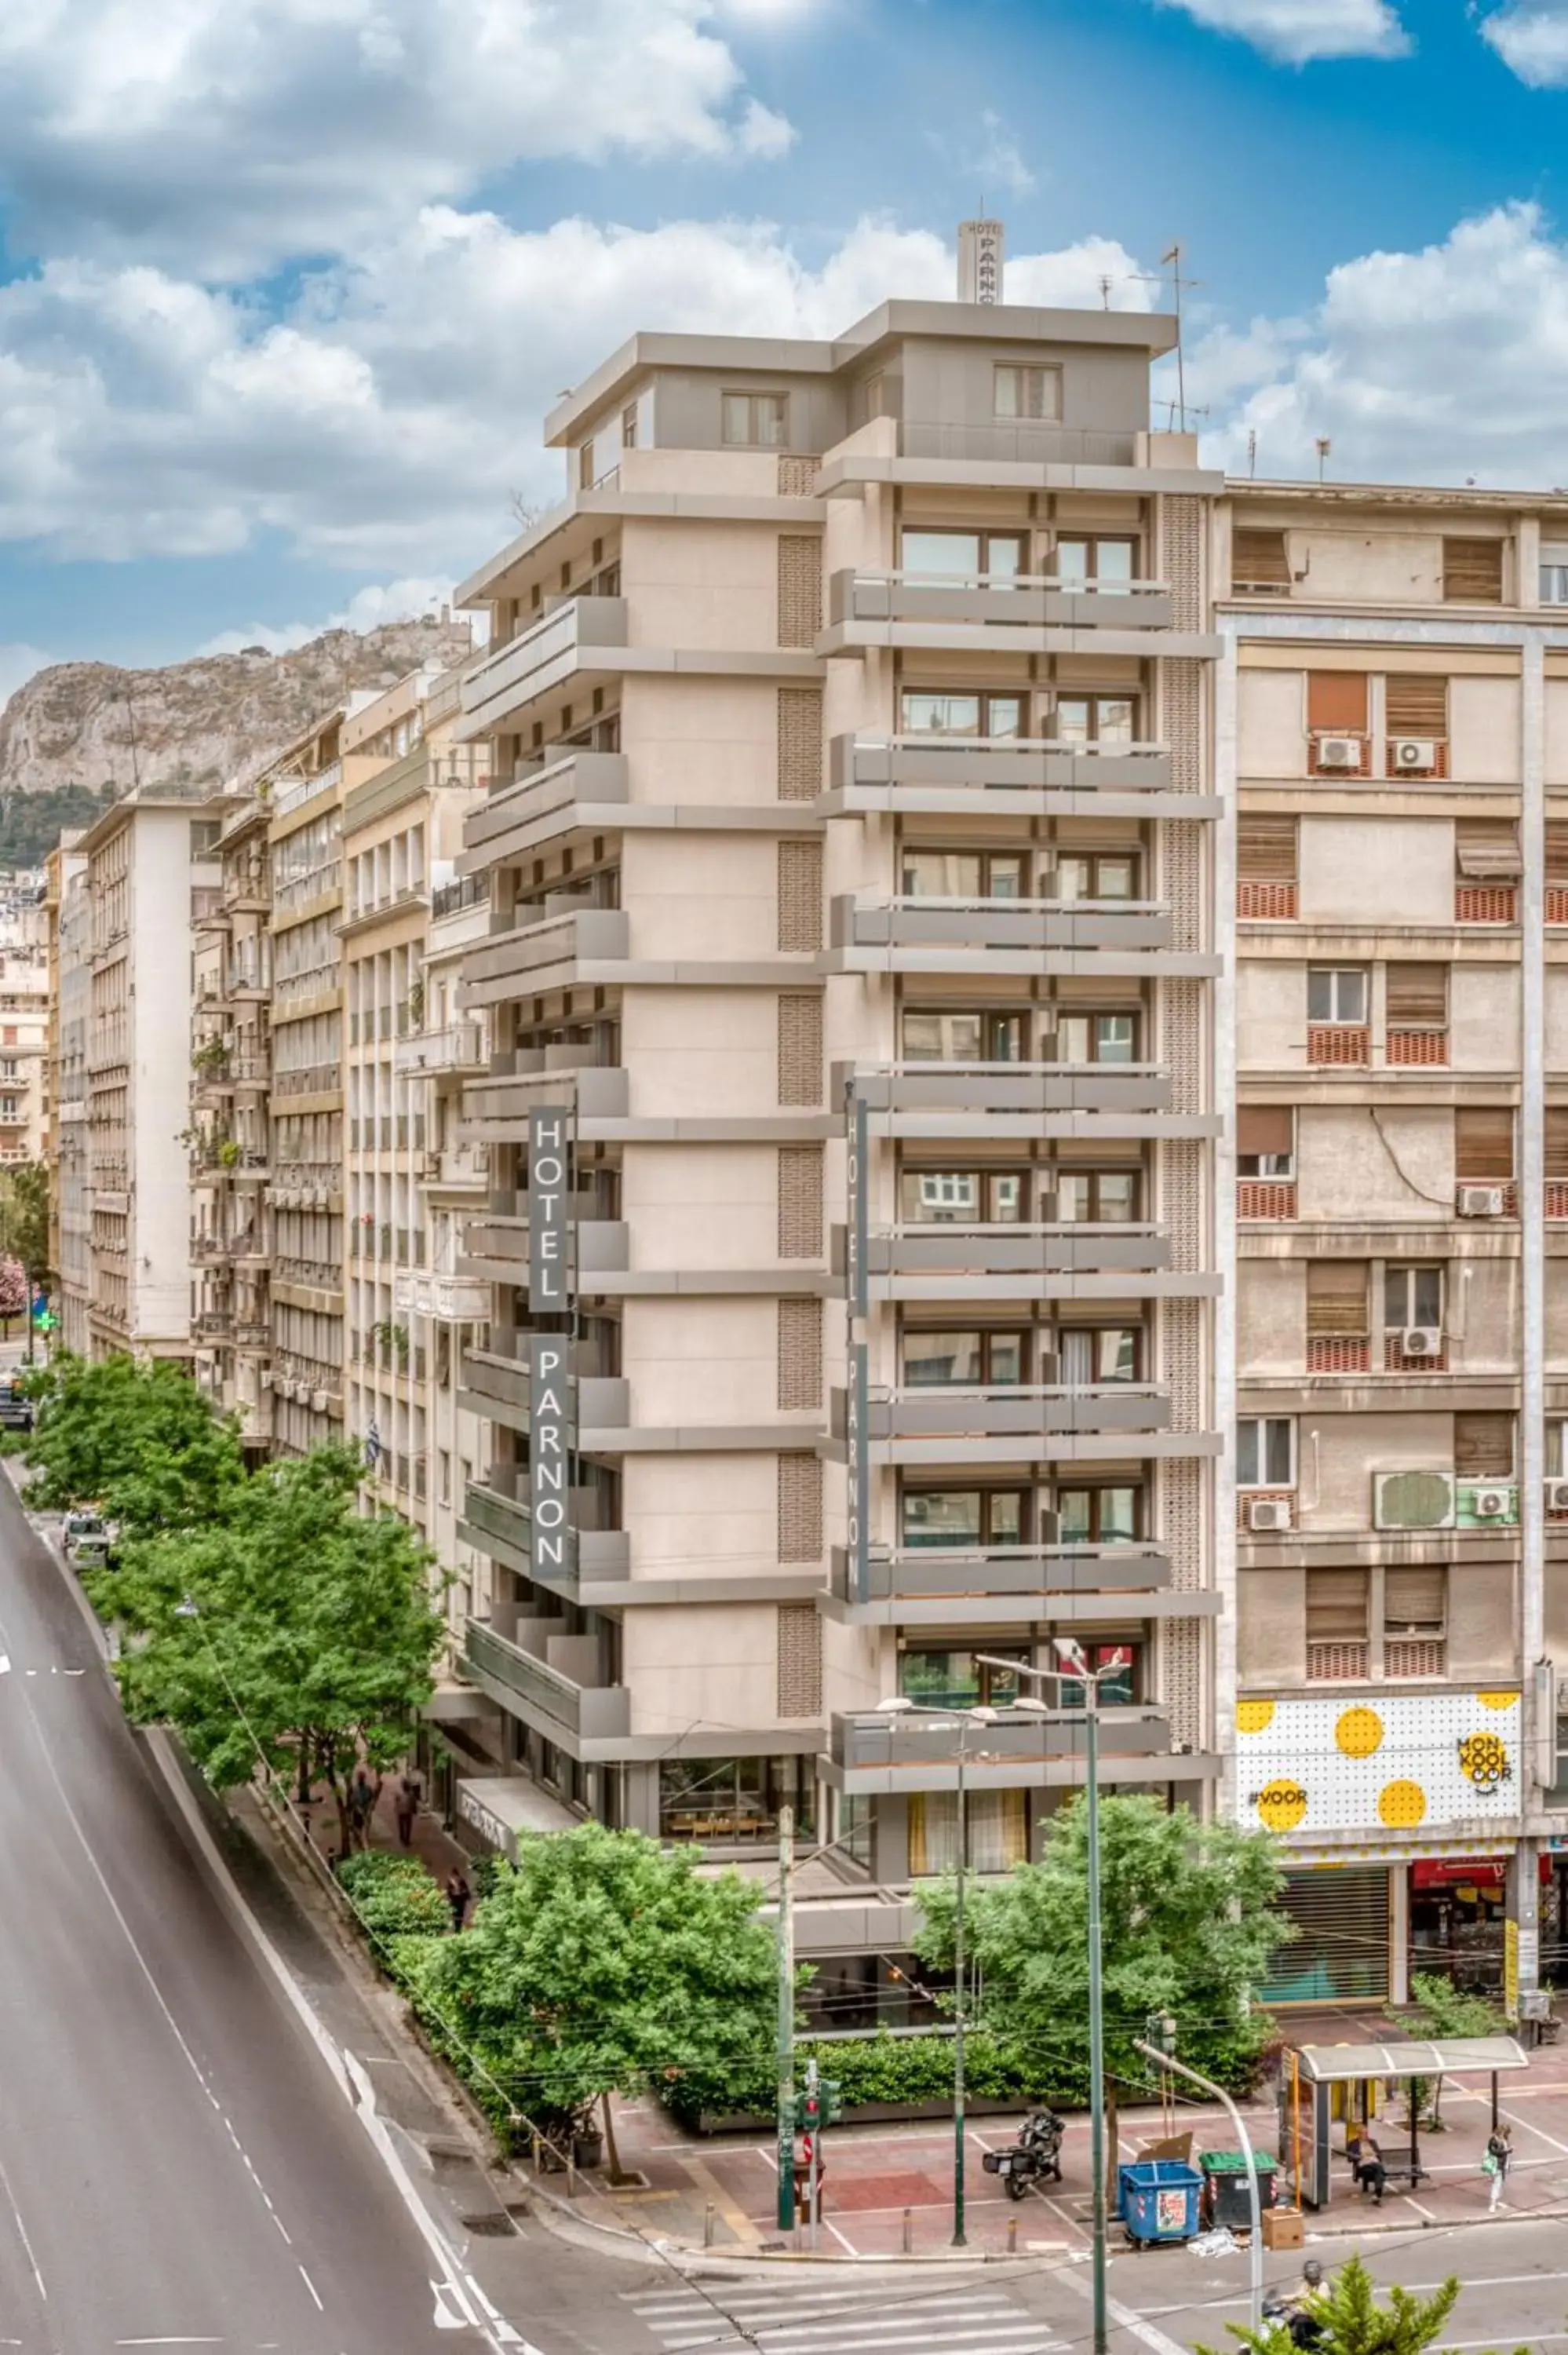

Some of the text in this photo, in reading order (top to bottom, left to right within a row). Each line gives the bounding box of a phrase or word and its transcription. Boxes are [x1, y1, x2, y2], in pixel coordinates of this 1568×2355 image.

[535, 1120, 561, 1297] HOTEL
[536, 1352, 564, 1565] PARNON
[1249, 1790, 1308, 1806] #VOOR
